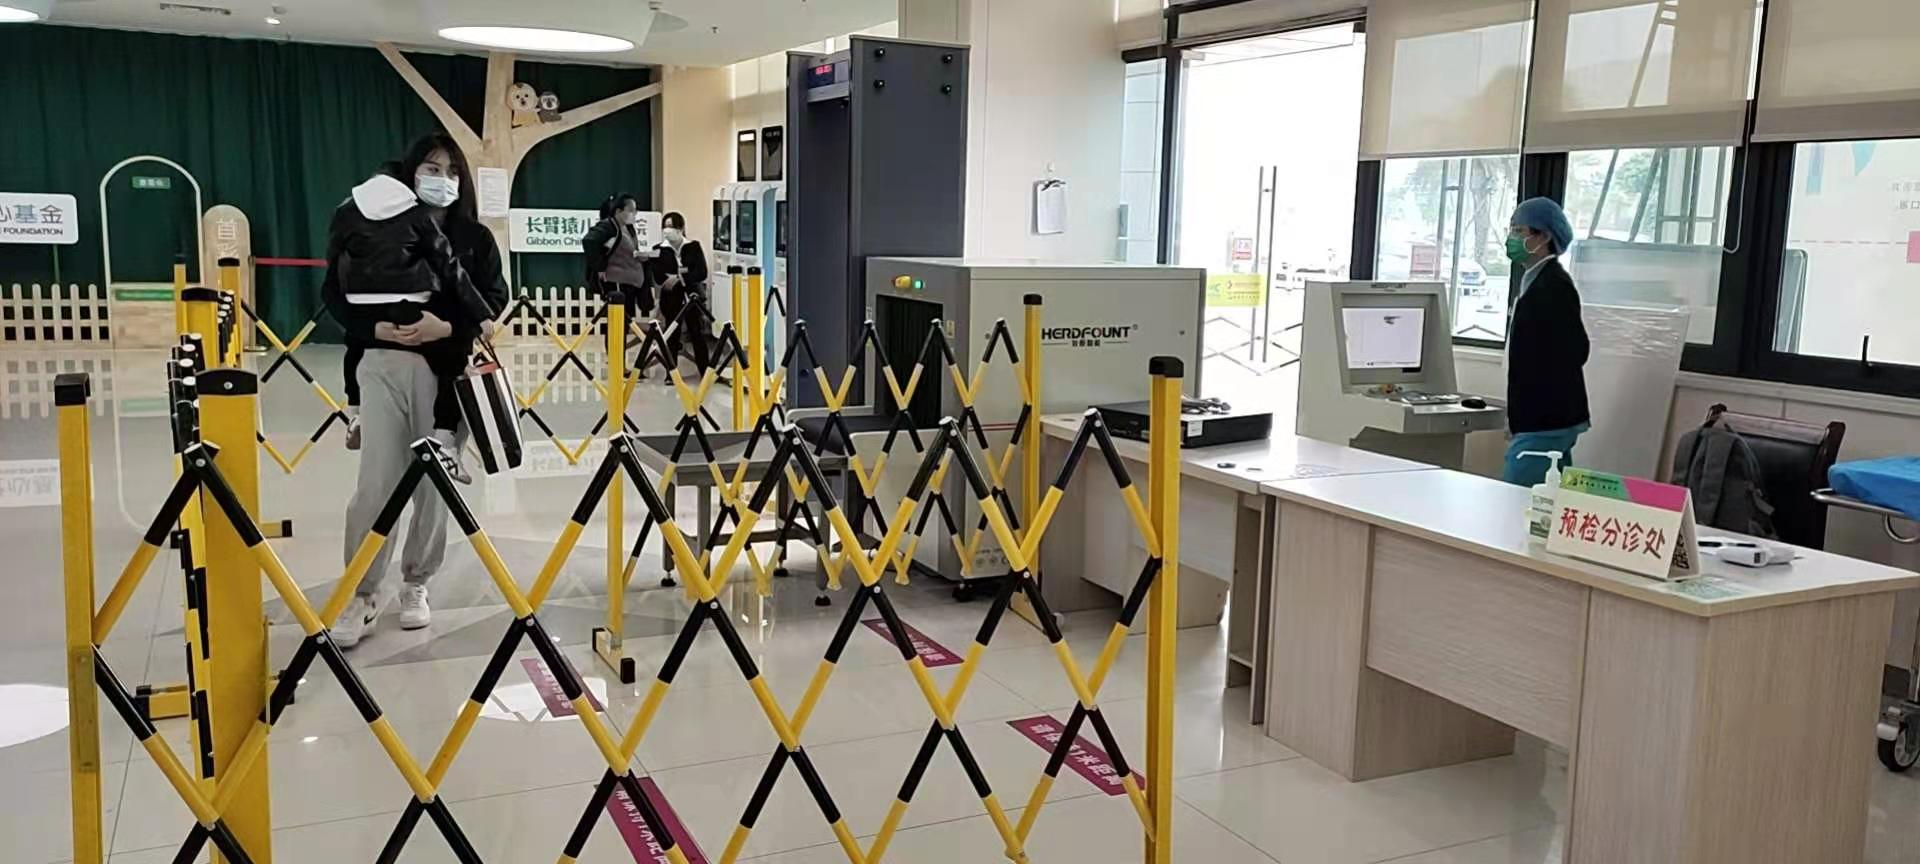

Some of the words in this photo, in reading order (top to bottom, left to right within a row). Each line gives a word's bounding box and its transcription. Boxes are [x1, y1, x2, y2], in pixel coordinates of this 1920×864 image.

[3, 227, 63, 235] FOUNDATION
[526, 236, 562, 246] Gibbon
[1041, 326, 1131, 340] HERDFOUNT
[1558, 507, 1666, 560] 预检分诊处
